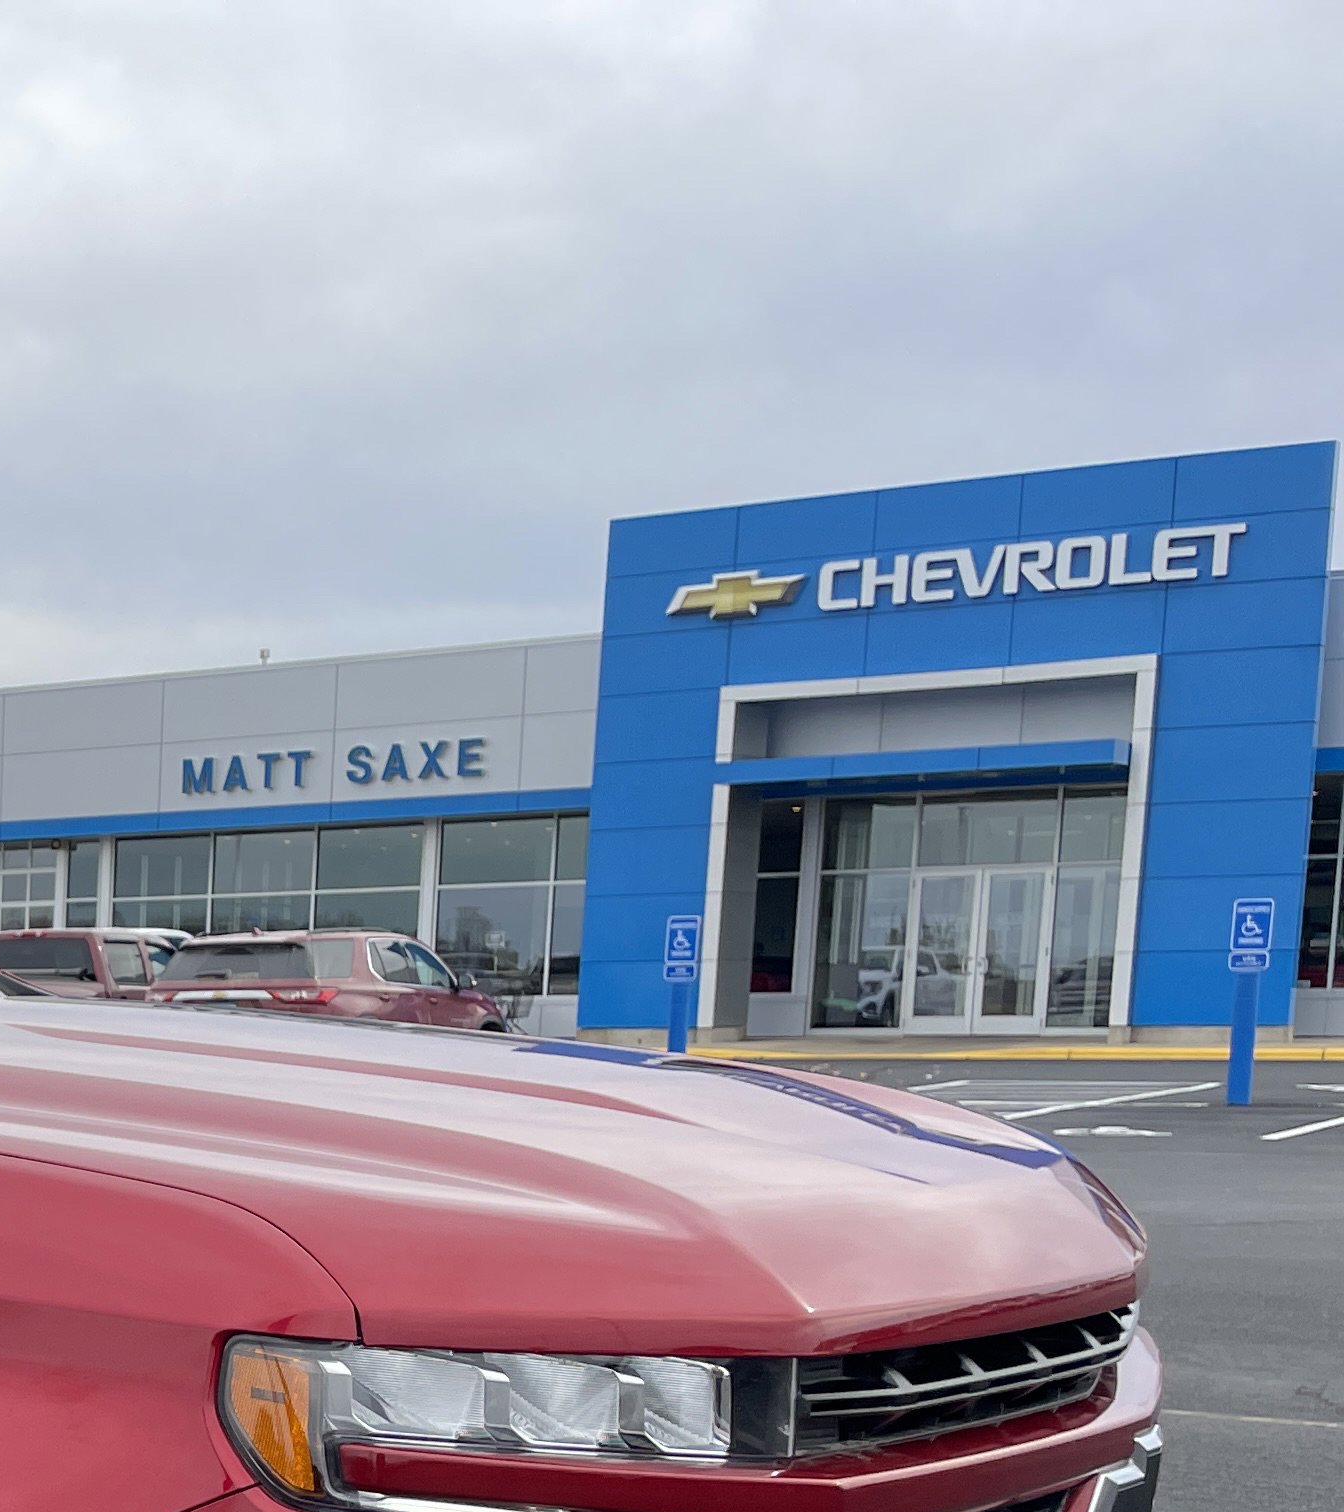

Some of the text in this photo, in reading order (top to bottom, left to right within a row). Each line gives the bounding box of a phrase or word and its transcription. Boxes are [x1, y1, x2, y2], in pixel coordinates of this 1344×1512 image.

[816, 522, 1248, 612] CHEVROLET
[180, 736, 488, 795] MATT SAXE
